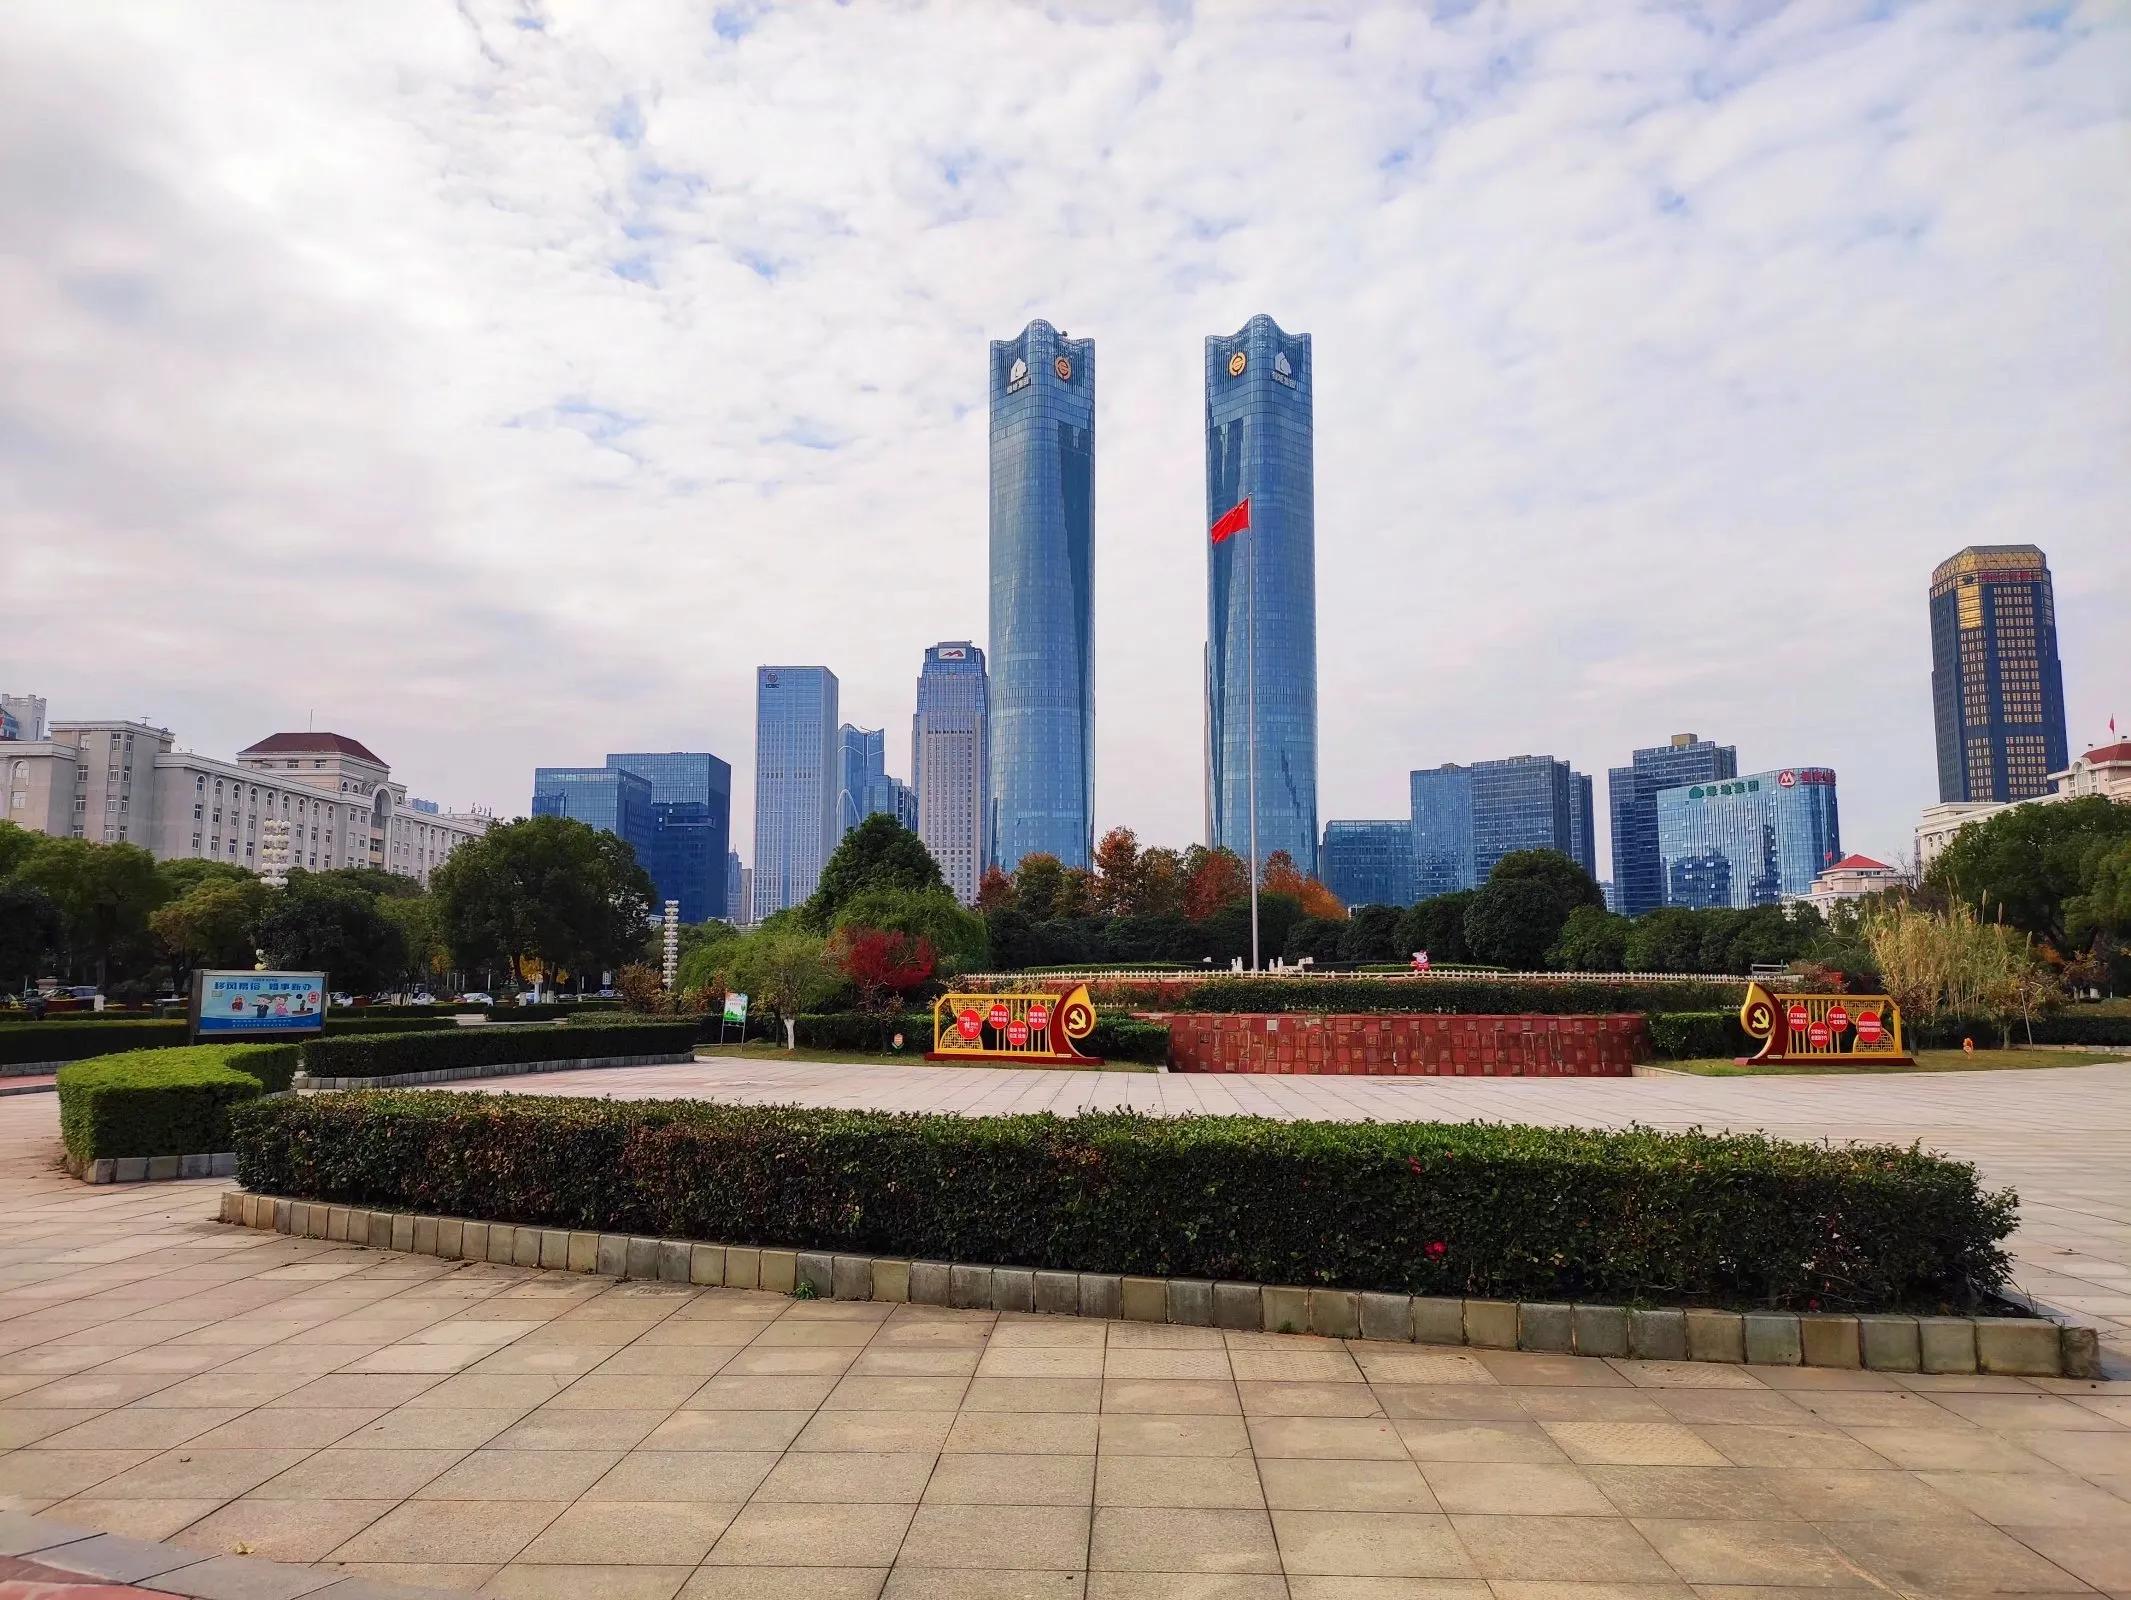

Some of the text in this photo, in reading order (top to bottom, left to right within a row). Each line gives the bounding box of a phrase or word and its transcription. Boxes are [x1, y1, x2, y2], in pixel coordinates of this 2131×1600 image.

[214, 981, 312, 991] 移风易俗 婚事新办
